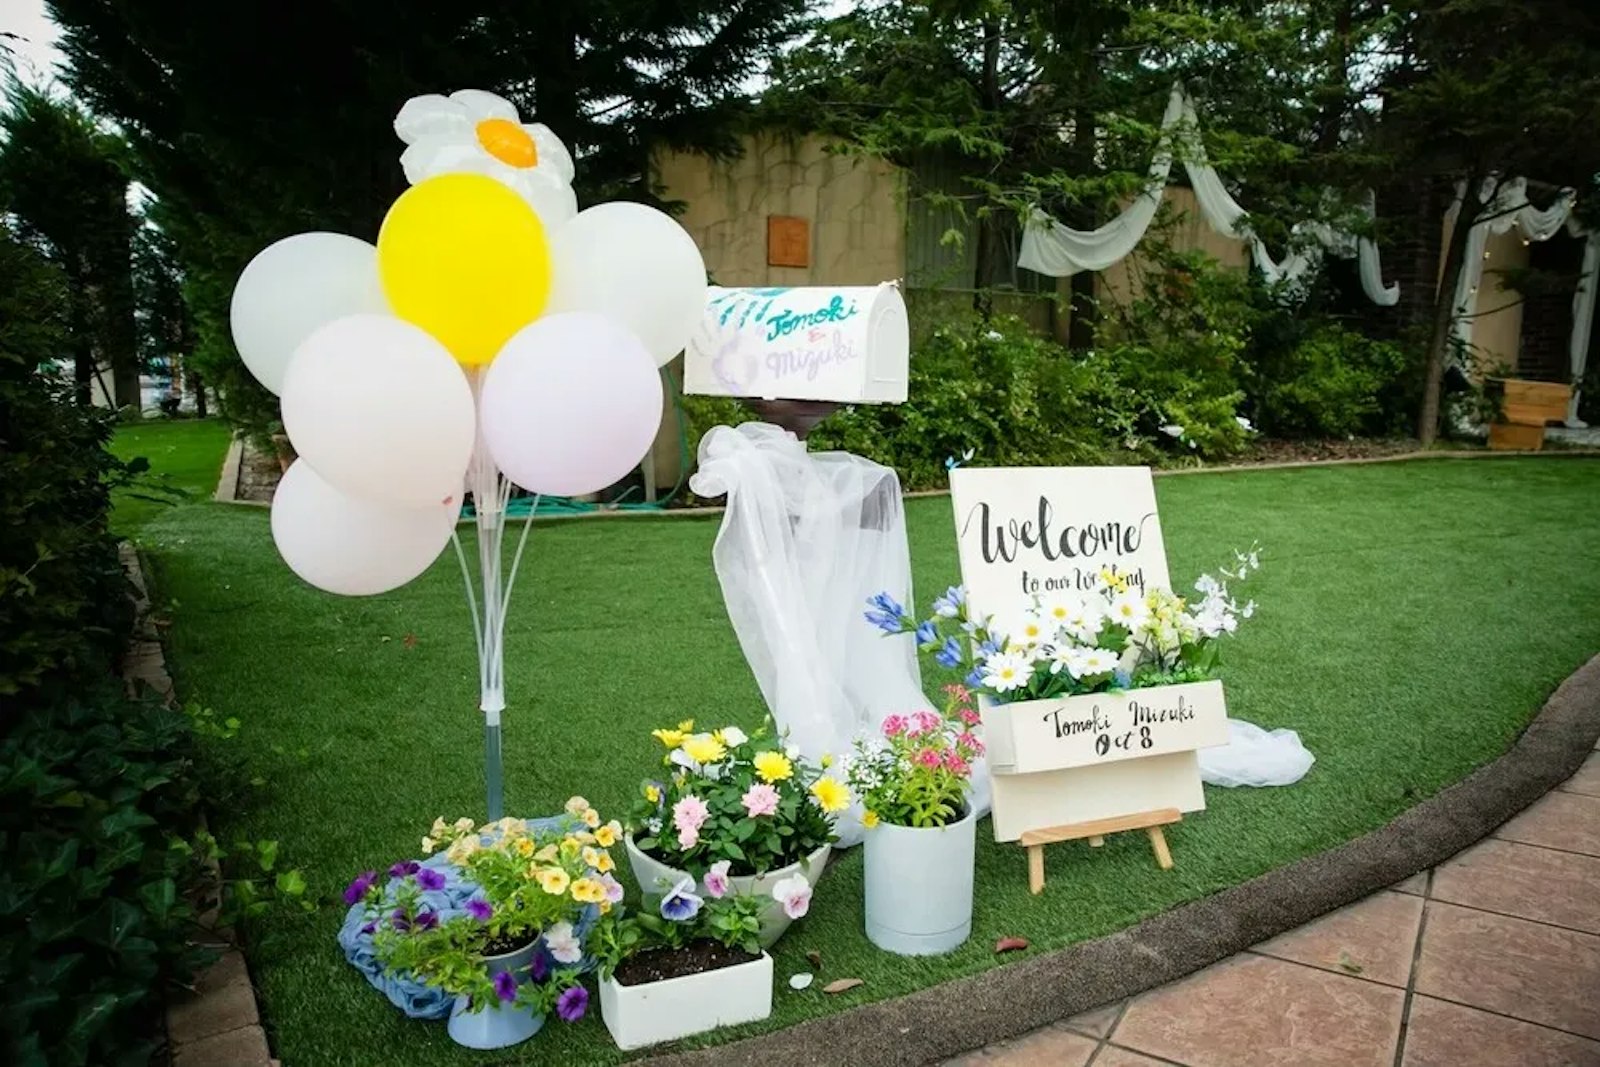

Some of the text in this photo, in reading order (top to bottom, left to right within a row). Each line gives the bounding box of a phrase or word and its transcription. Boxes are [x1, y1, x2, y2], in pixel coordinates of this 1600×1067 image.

[766, 330, 859, 381] Mizuki
[961, 495, 1157, 563] Welcome
[1021, 570, 1040, 595] to
[1045, 576, 1070, 591] our
[1043, 695, 1196, 738] Tomoki Mizuki
[1095, 726, 1153, 756] Oct 8
